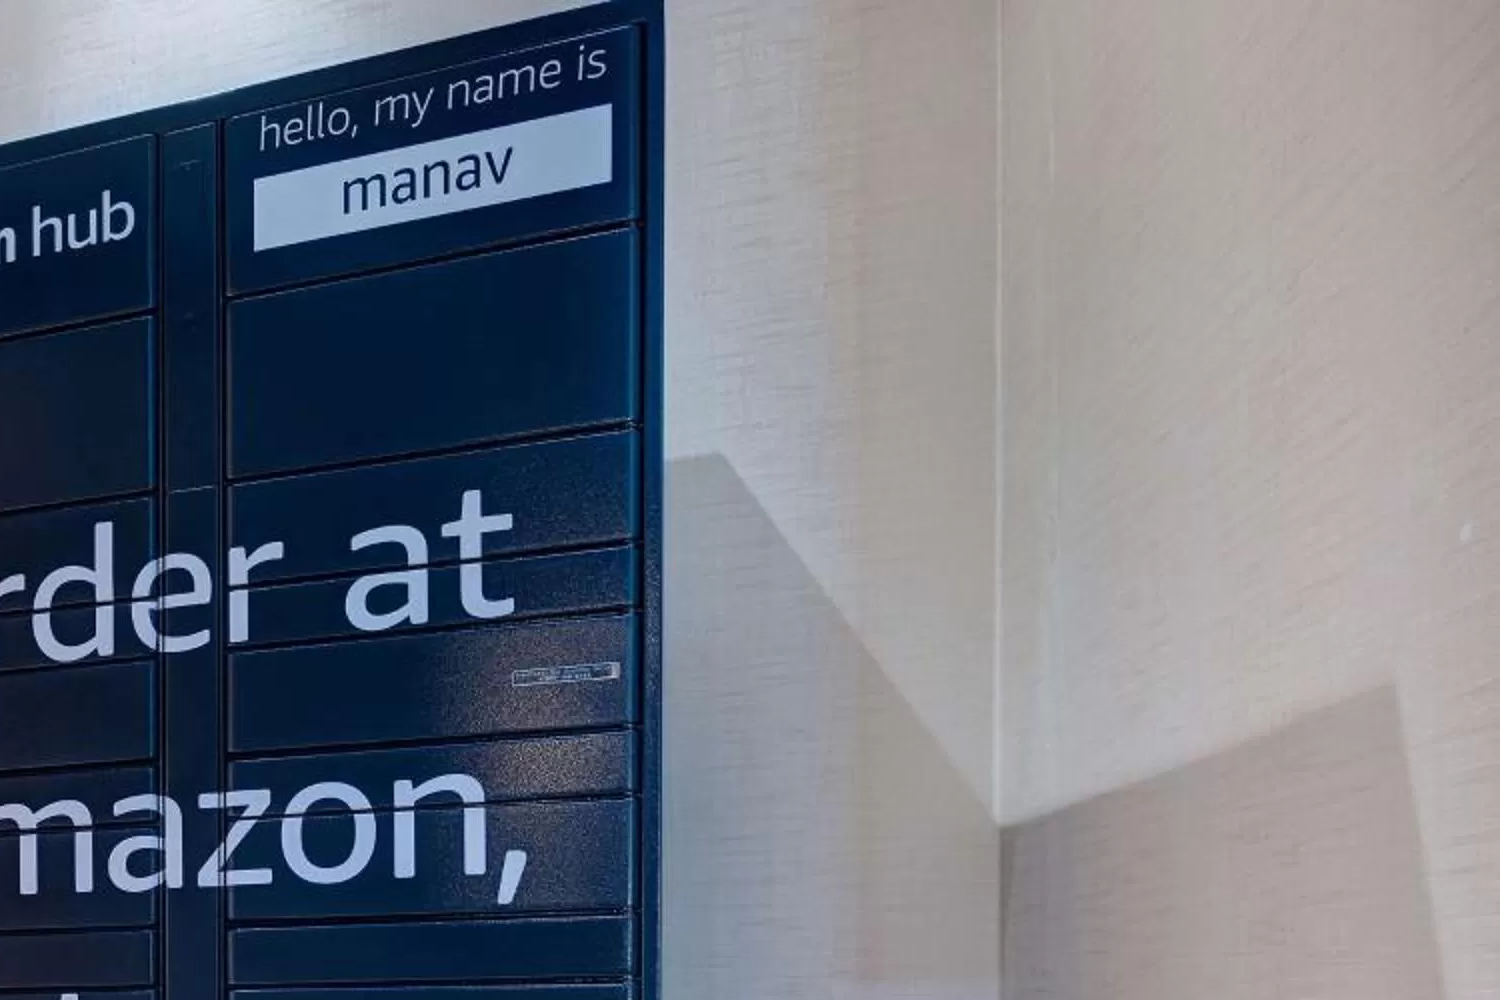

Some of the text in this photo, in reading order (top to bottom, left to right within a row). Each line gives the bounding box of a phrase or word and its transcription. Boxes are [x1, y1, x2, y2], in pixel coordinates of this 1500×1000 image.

[260, 44, 607, 151] hello, my name is
[32, 189, 135, 257] hub
[343, 146, 513, 215] manav
[345, 489, 515, 631] at
